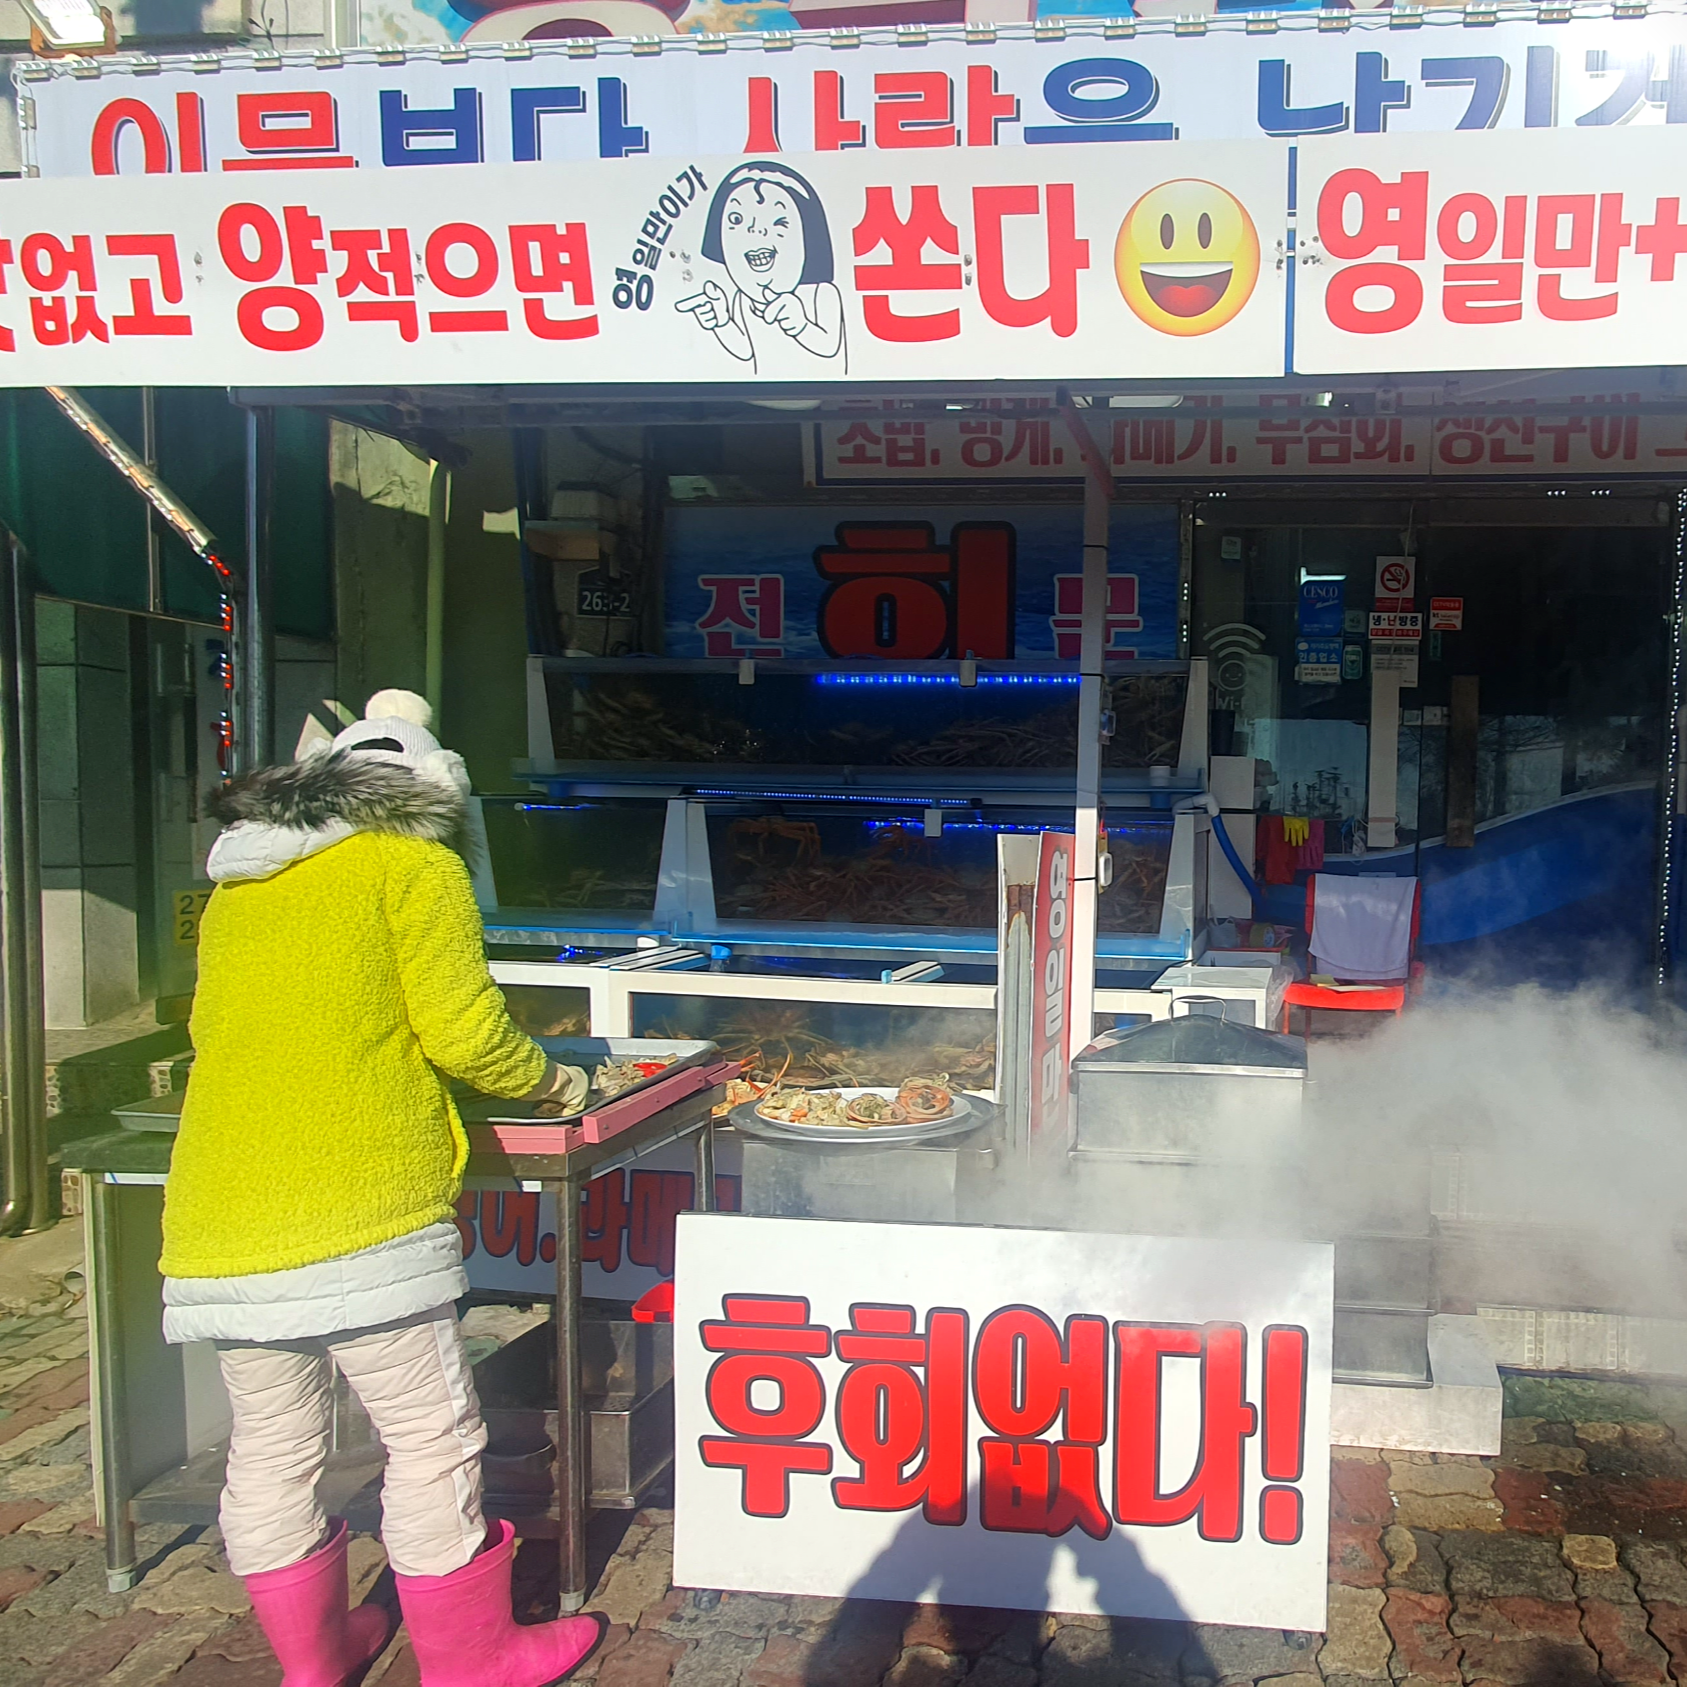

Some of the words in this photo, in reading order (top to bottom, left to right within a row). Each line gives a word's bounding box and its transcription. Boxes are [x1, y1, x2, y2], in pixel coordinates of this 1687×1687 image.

[218, 202, 600, 351] 양적으면
[612, 164, 708, 311] 영일만이가
[852, 183, 1091, 342] 쏜다
[1298, 651, 1339, 662] 인증업소
[1303, 585, 1338, 599] CESCO
[698, 1291, 1309, 1546] 후회없다!
